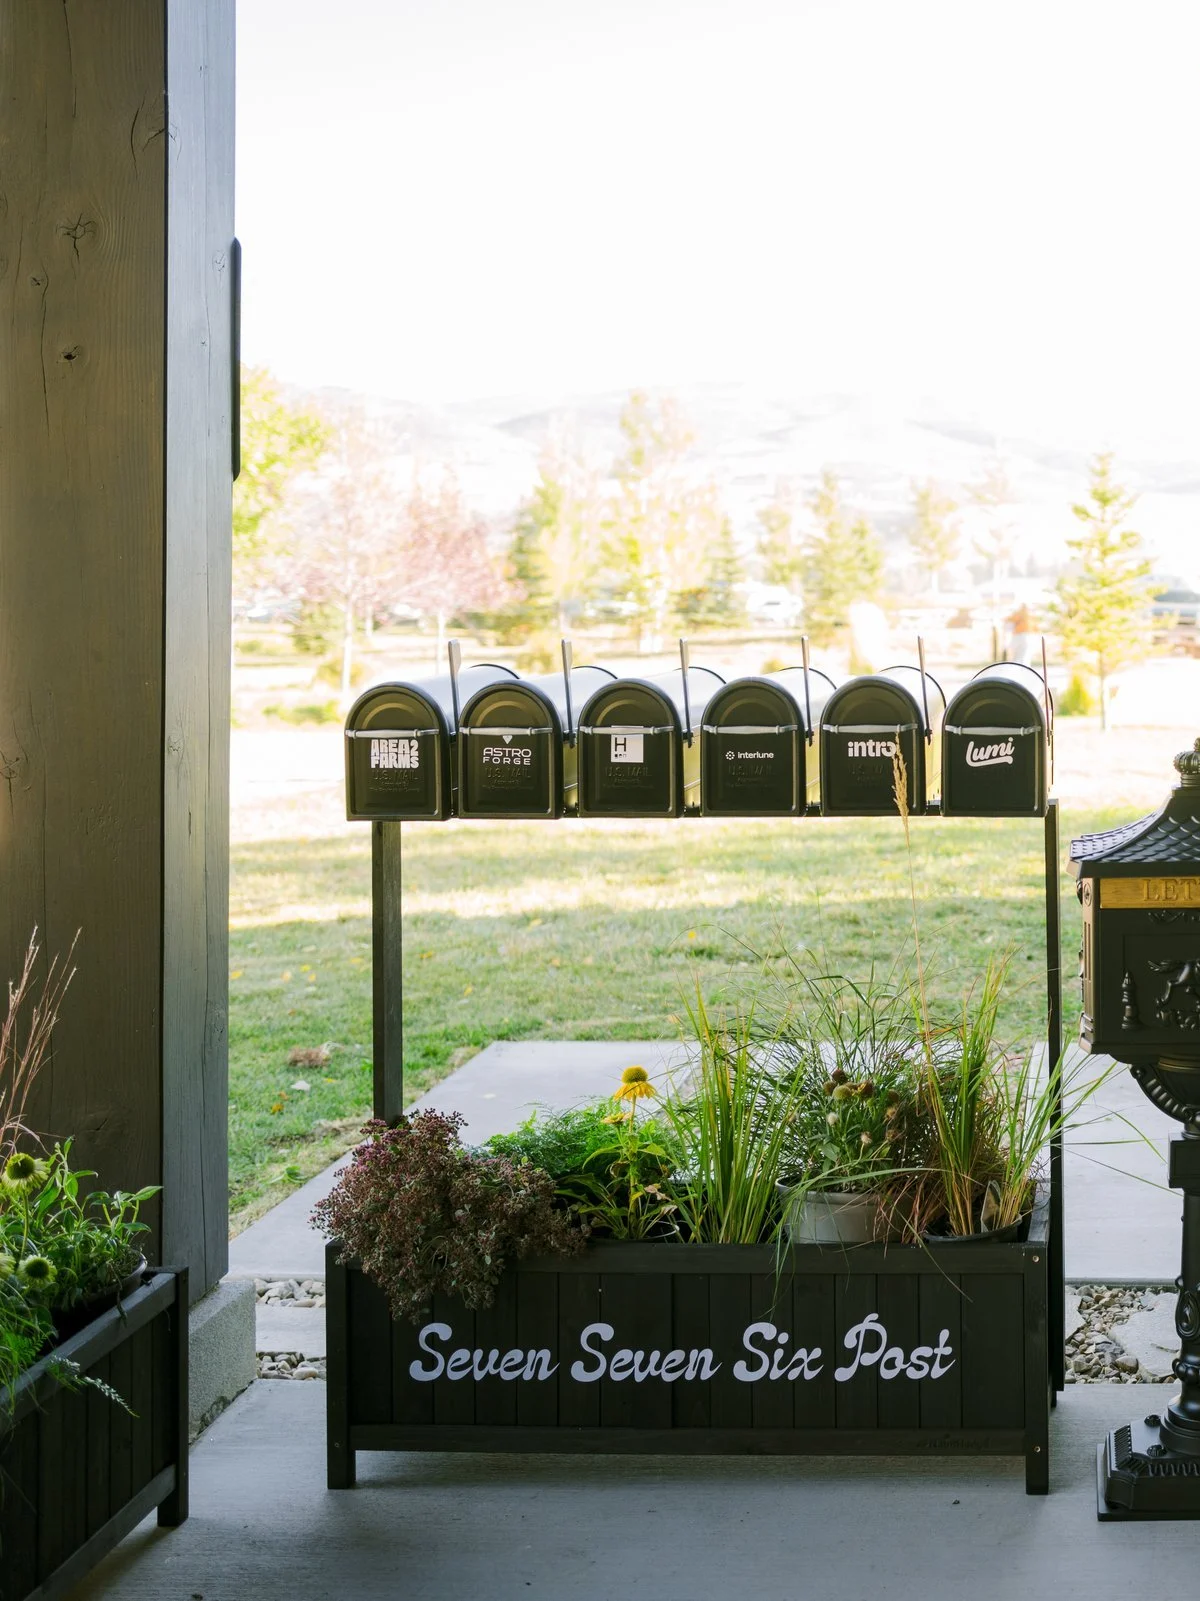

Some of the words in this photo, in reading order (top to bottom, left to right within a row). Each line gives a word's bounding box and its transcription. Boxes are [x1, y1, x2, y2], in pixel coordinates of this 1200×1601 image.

[371, 739, 419, 756] AREA2
[614, 737, 627, 752] H
[847, 739, 897, 757] intro
[483, 747, 532, 758] ASTRO
[737, 751, 775, 759] interlune
[371, 754, 420, 769] FARMS
[482, 756, 532, 766] FORGE
[409, 1323, 560, 1382] Seven
[570, 1323, 722, 1383] Seven
[732, 1322, 825, 1382] Six
[833, 1312, 956, 1382] Post
